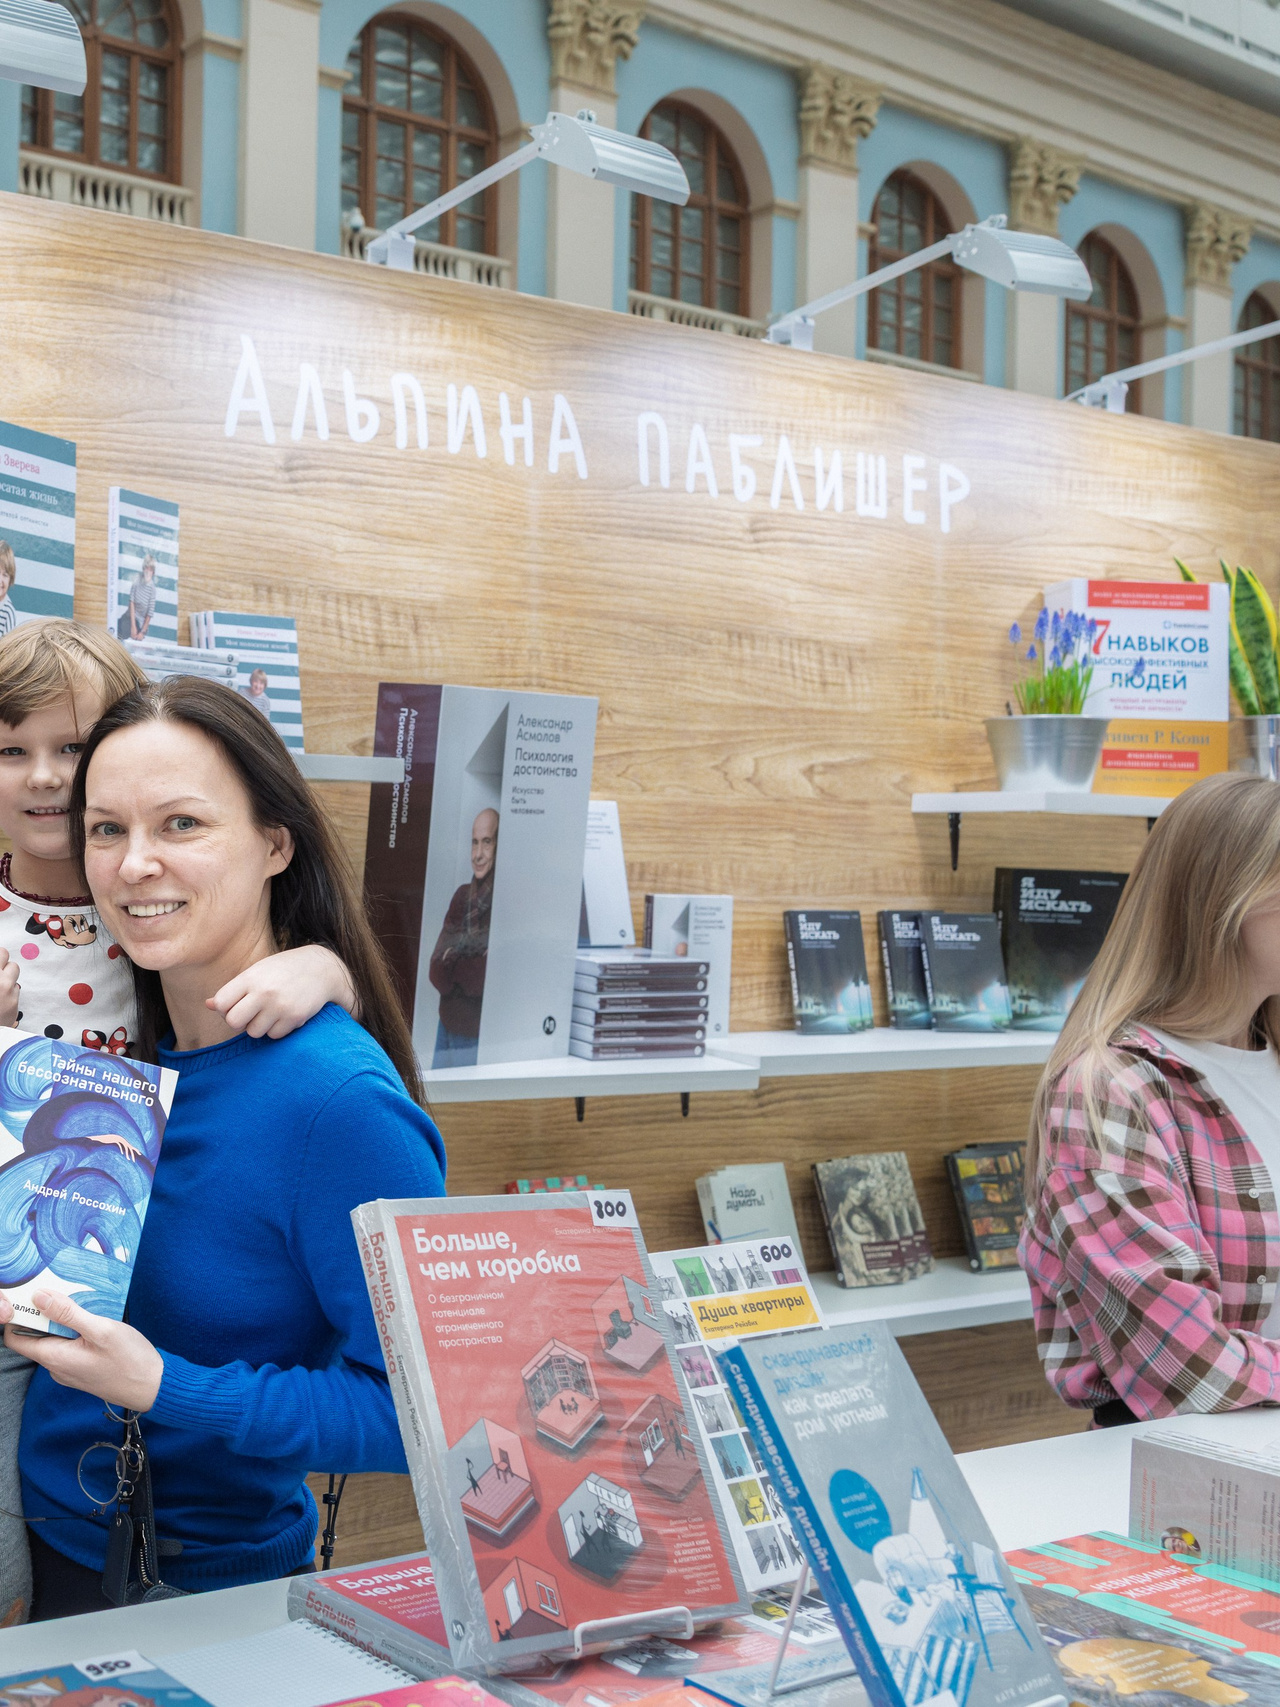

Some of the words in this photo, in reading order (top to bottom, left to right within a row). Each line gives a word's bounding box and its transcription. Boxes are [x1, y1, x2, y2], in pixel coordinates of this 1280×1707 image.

[224, 334, 588, 480] АЛЬПИНА
[637, 411, 971, 534] ПАБЛИШЕР
[3, 453, 41, 474] Зверева
[29, 489, 59, 506] жизнь
[1108, 635, 1209, 653] НАВЫКОВ
[1111, 670, 1187, 692] ЛЮДЕЙ
[517, 713, 573, 733] Александр
[404, 708, 419, 772] Александр
[516, 728, 561, 743] Асмолов
[1104, 732, 1149, 744] тивен
[1171, 731, 1210, 745] Кови
[515, 747, 574, 763] Психология
[513, 765, 578, 778] достоинства
[401, 773, 413, 824] Асмолов
[511, 786, 545, 795] Искусство
[511, 796, 526, 804] быть
[389, 782, 400, 849] остоинства
[1020, 888, 1061, 900] ИДУ
[1019, 899, 1093, 913] ИСКАТЬ
[17, 1061, 155, 1107] бессознательного
[51, 1053, 97, 1078] Тайны
[102, 1070, 157, 1094] нашего
[23, 1179, 68, 1200] Андрей
[71, 1191, 126, 1216] Россохин
[726, 1194, 766, 1212] думать!
[729, 1187, 756, 1199] Надо
[412, 1228, 518, 1254] Больше,
[554, 1227, 591, 1236] Екатерина
[760, 1243, 792, 1263] 600
[371, 1231, 396, 1319] Больше,
[419, 1260, 472, 1281] чем
[477, 1249, 582, 1283] коробка
[360, 1237, 375, 1279] чем
[371, 1284, 397, 1375] коробка
[427, 1294, 437, 1304] О
[439, 1291, 505, 1305] безграничном
[698, 1305, 738, 1322] Душа
[741, 1295, 805, 1314] квартиры
[431, 1307, 486, 1319] потенциале
[435, 1320, 504, 1333] ограниченного
[703, 1324, 734, 1333] Екатерина
[735, 1320, 758, 1329] Рейзбих
[438, 1335, 503, 1349] пространства
[762, 1332, 873, 1370] скандинавский
[396, 1354, 412, 1405] Екатерина
[773, 1368, 828, 1396] дизайн
[781, 1396, 812, 1416] как
[813, 1385, 875, 1412] сделать
[793, 1417, 827, 1442] дом
[827, 1403, 889, 1434] уютным
[729, 1362, 802, 1500] скандинавский
[792, 1504, 832, 1573] дизайн
[1090, 1564, 1188, 1592] НЕВИДИМЫЕ
[1120, 1574, 1207, 1599] ЖЕНЩИНЫ
[356, 1584, 409, 1597] чем
[305, 1590, 359, 1635] Больше,
